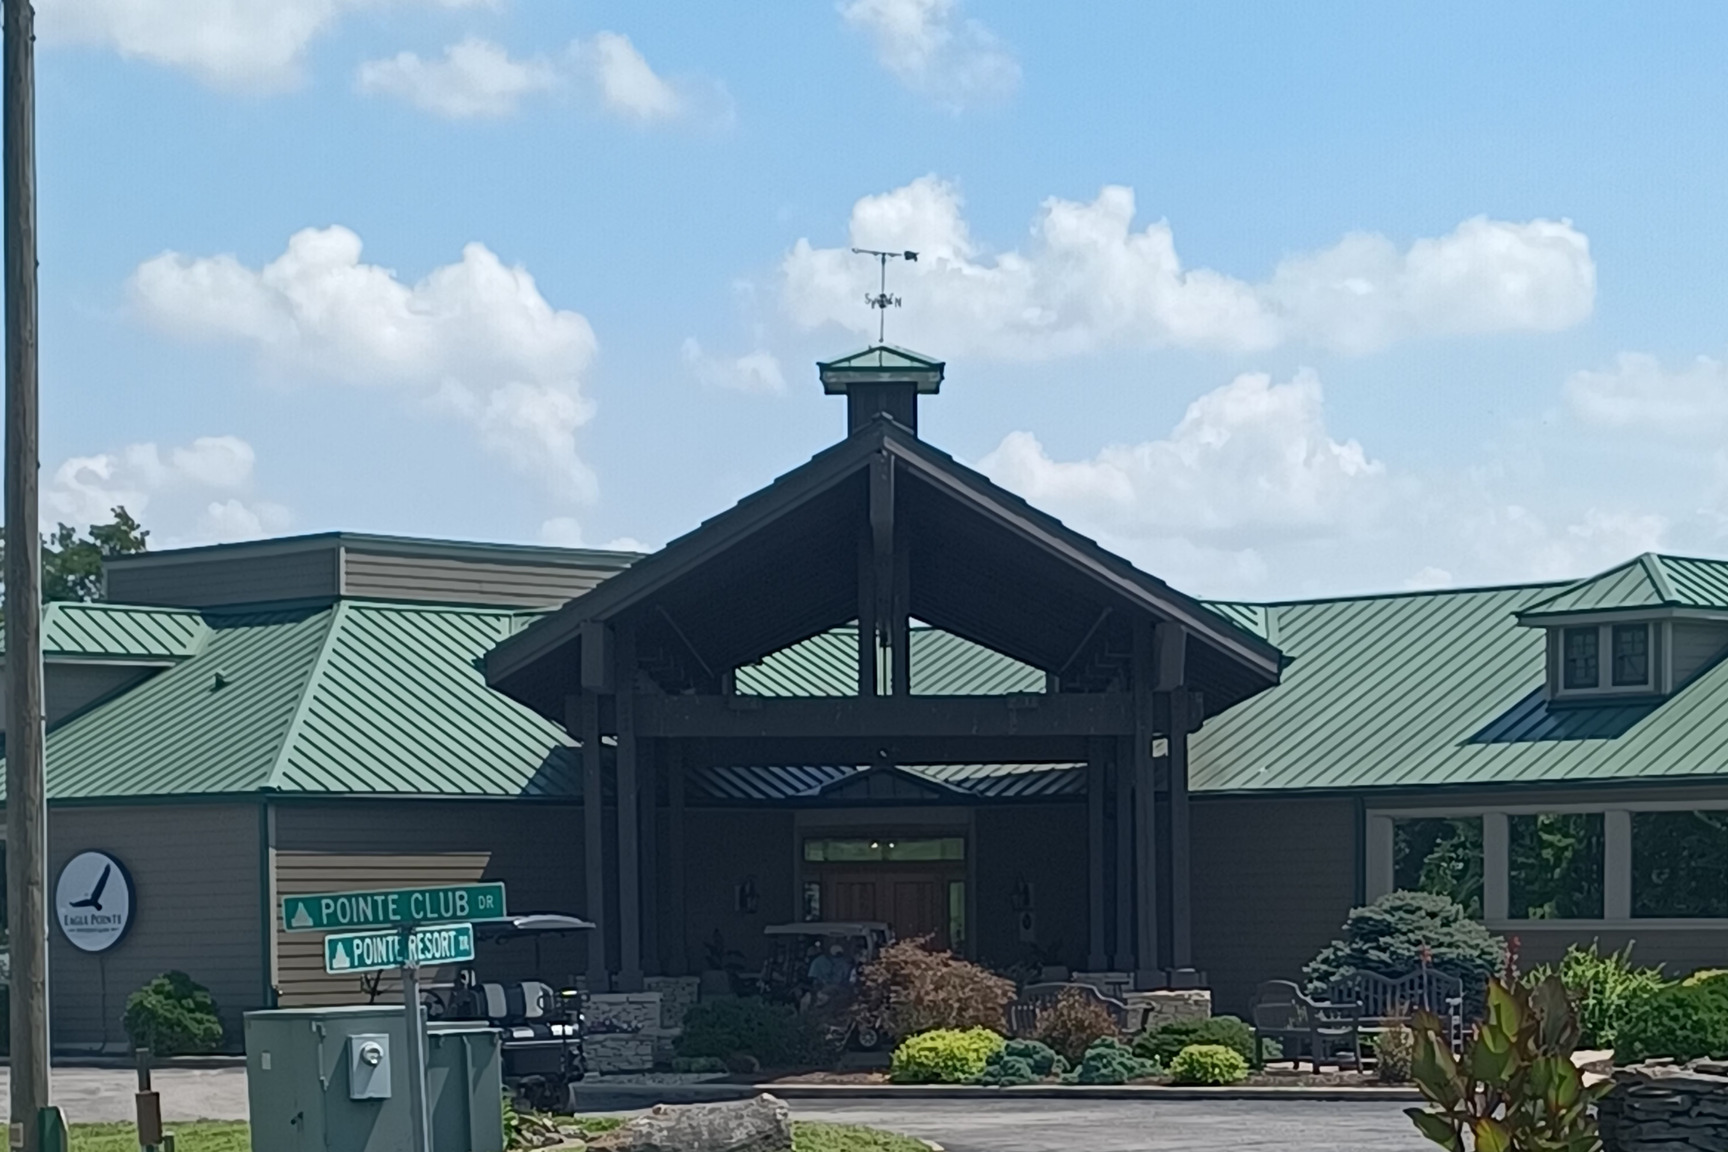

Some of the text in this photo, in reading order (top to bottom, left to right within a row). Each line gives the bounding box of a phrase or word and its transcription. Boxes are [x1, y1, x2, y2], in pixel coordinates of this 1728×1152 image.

[321, 891, 494, 925] POINTE CLUB DR
[353, 936, 403, 966] POINTE
[408, 931, 456, 961] RESORT
